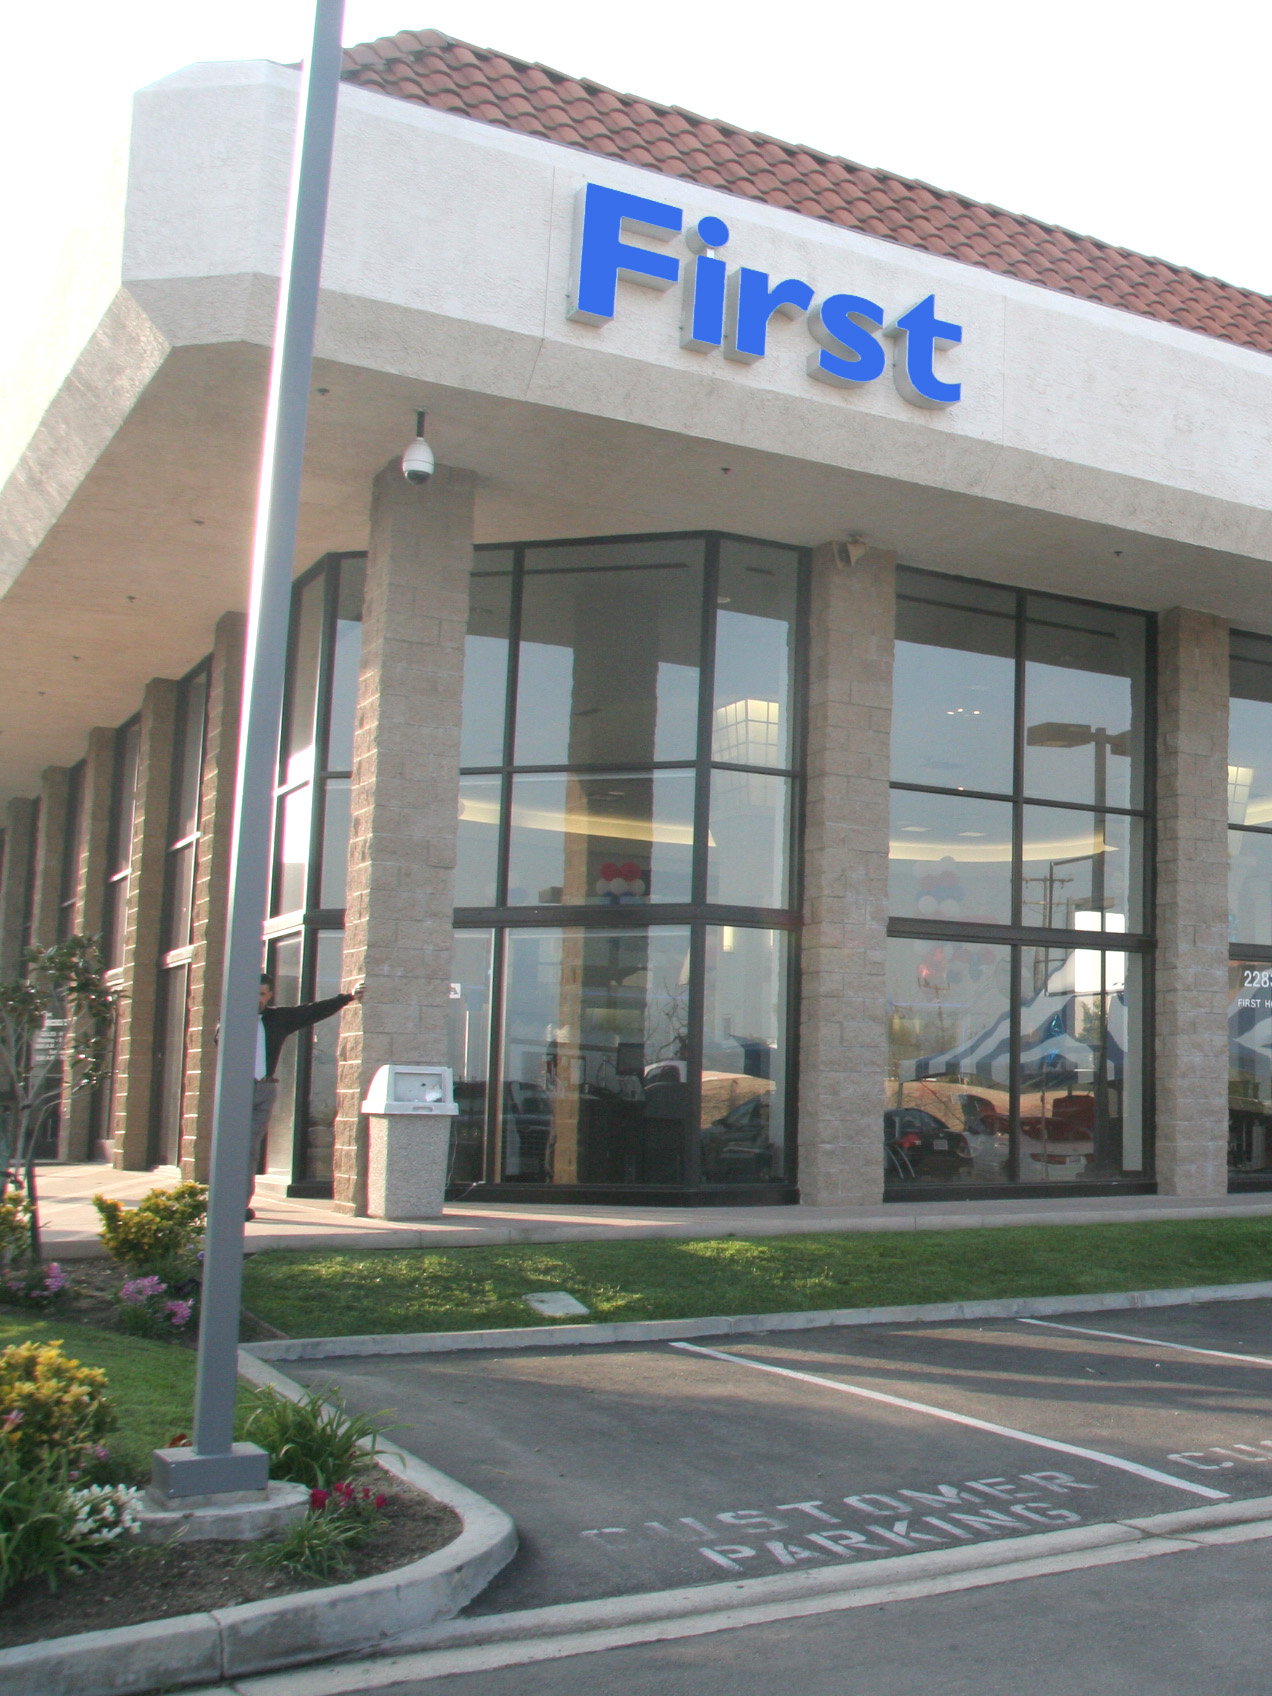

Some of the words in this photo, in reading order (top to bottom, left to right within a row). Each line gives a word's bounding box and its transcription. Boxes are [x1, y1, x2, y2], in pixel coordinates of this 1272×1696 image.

[576, 182, 963, 403] First
[1237, 998, 1262, 1008] FIRST
[697, 1502, 1083, 1572] PARKING
